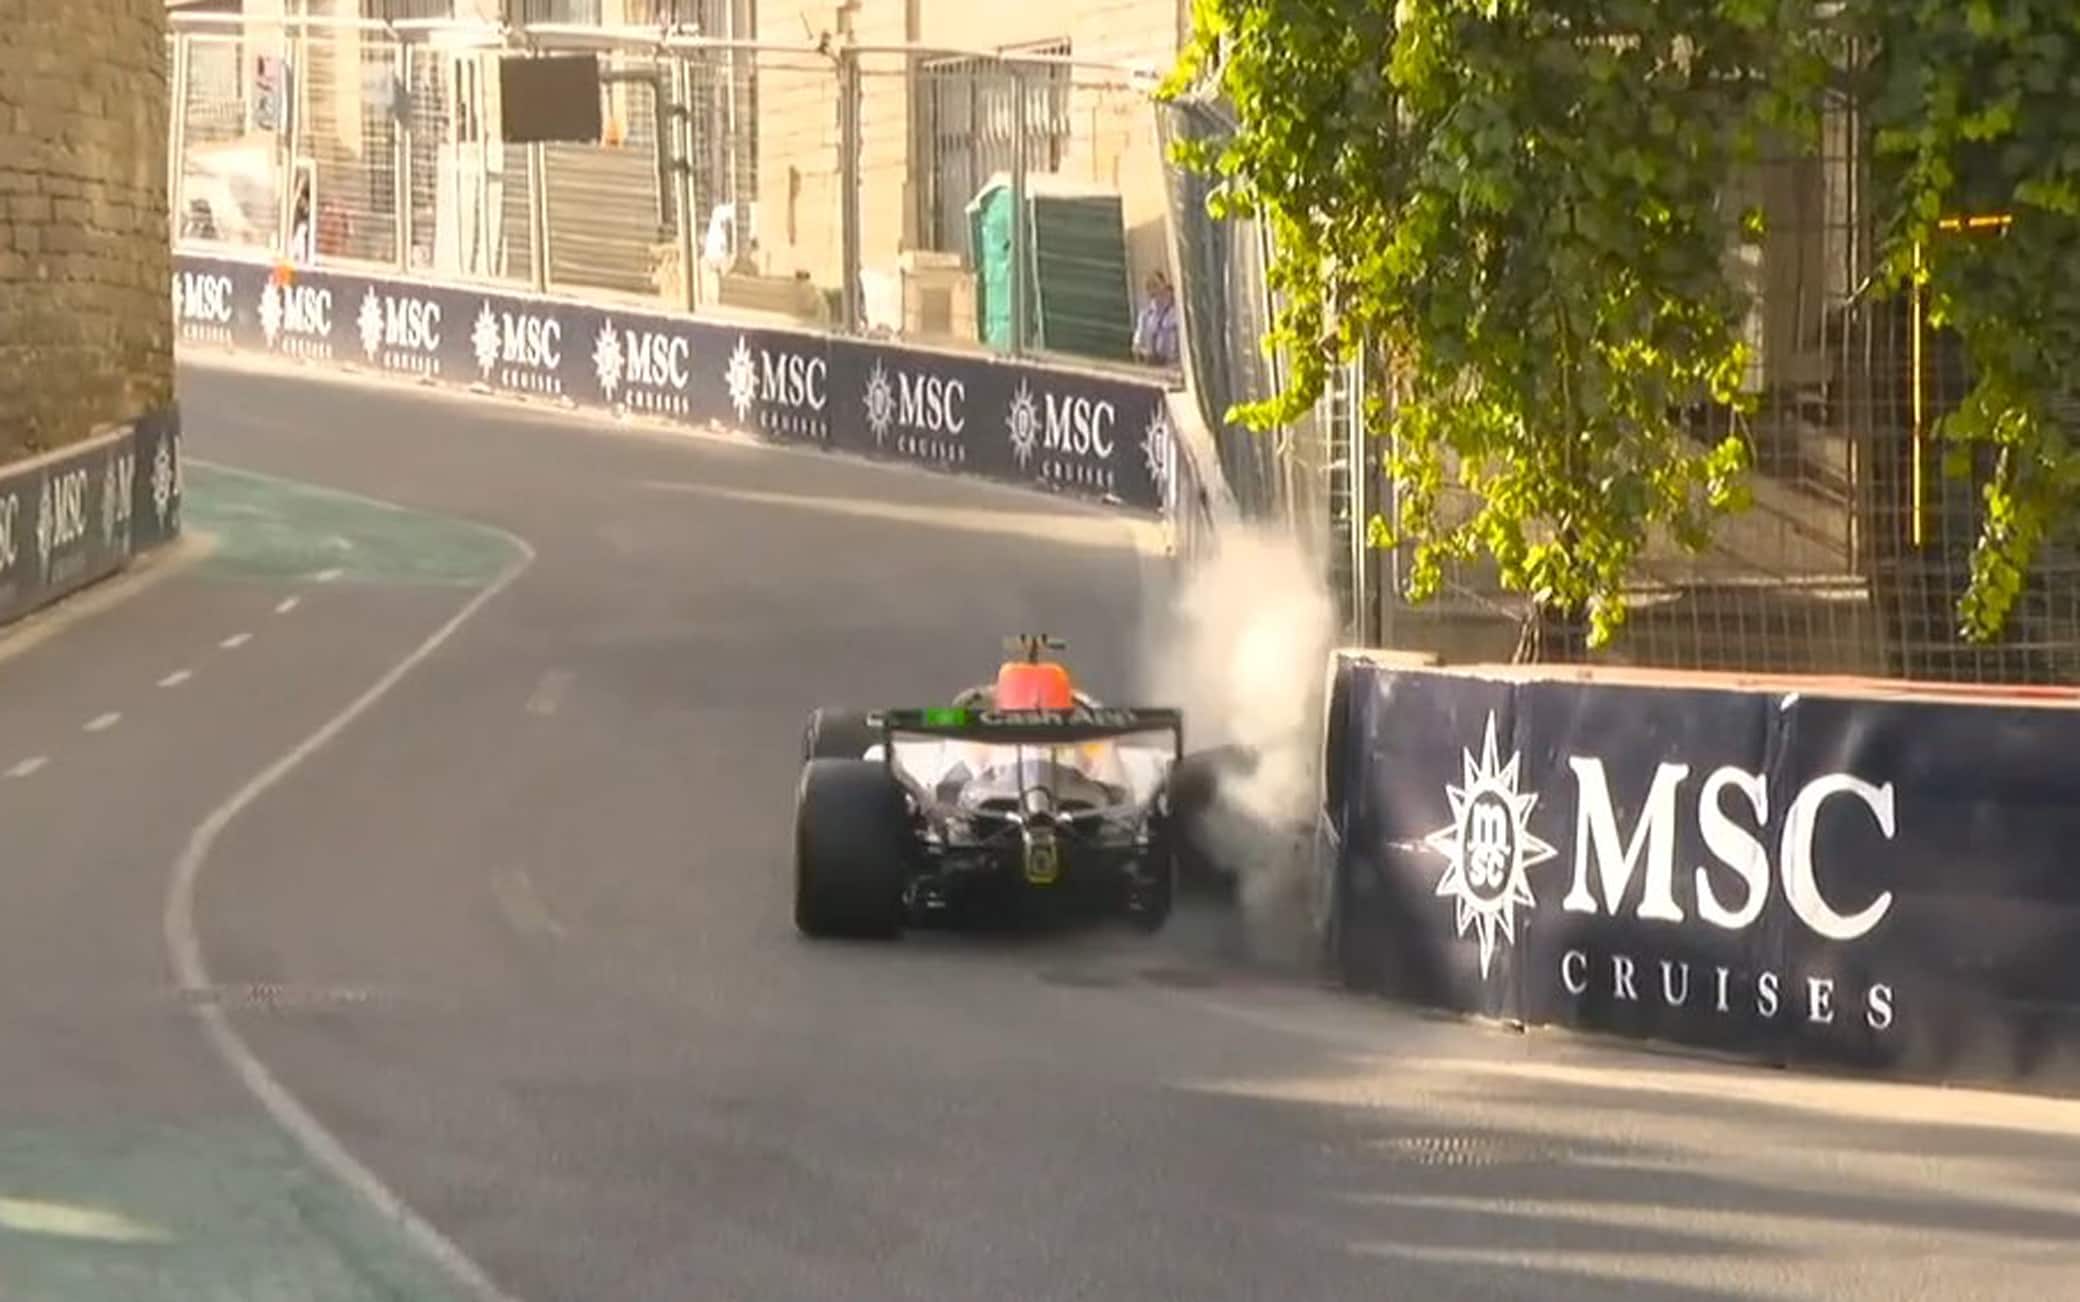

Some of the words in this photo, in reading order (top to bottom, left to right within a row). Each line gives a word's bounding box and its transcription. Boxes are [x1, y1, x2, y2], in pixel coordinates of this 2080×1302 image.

[185, 272, 232, 322] MSC
[283, 286, 332, 336] MSC
[385, 296, 441, 350] MSC
[501, 313, 561, 369] MSC
[626, 329, 690, 389] MSC
[760, 350, 827, 410] MSC
[898, 371, 966, 433] MSC
[1043, 393, 1115, 458] MSC
[1562, 756, 1896, 940] MSC
[1561, 949, 1895, 1030] CRUISES
